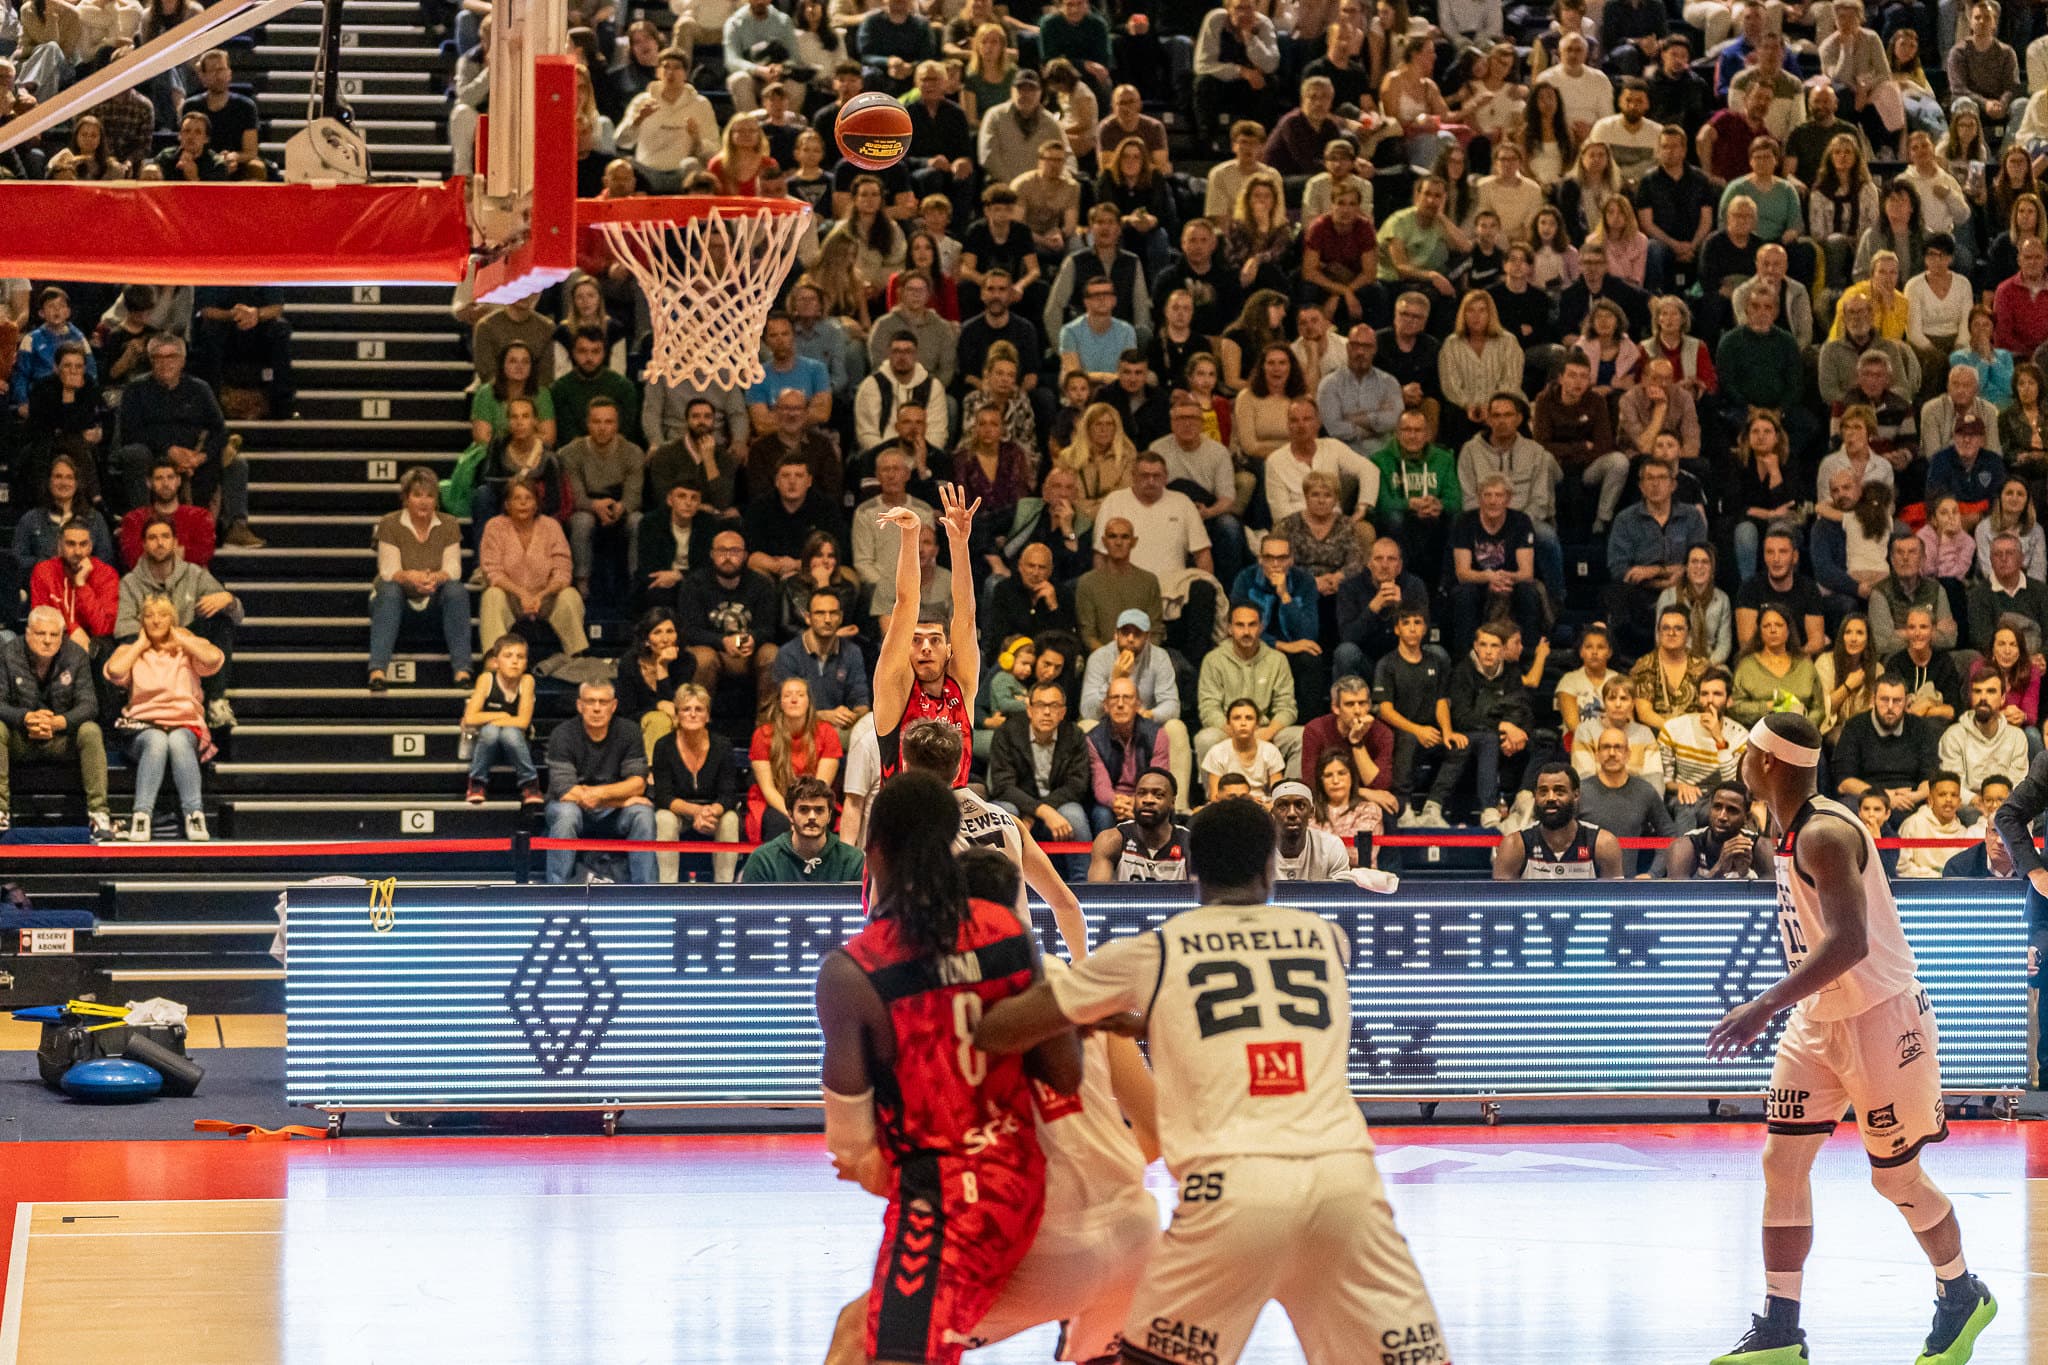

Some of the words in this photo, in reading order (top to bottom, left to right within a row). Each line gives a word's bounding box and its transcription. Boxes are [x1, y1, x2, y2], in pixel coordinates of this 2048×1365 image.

[361, 288, 373, 300] K
[367, 343, 376, 358] J
[376, 463, 388, 477] H
[395, 664, 406, 679] E
[403, 737, 416, 752] D
[411, 813, 424, 828] C
[960, 812, 1015, 833] EWSKI
[1181, 929, 1324, 954] NORELIA
[1188, 958, 1332, 1040] 25
[1769, 1088, 1810, 1104] QUIP
[961, 1171, 979, 1204] 8
[1184, 1172, 1224, 1202] 25
[1151, 1317, 1218, 1349] CAEN
[1147, 1332, 1218, 1365] REPRO
